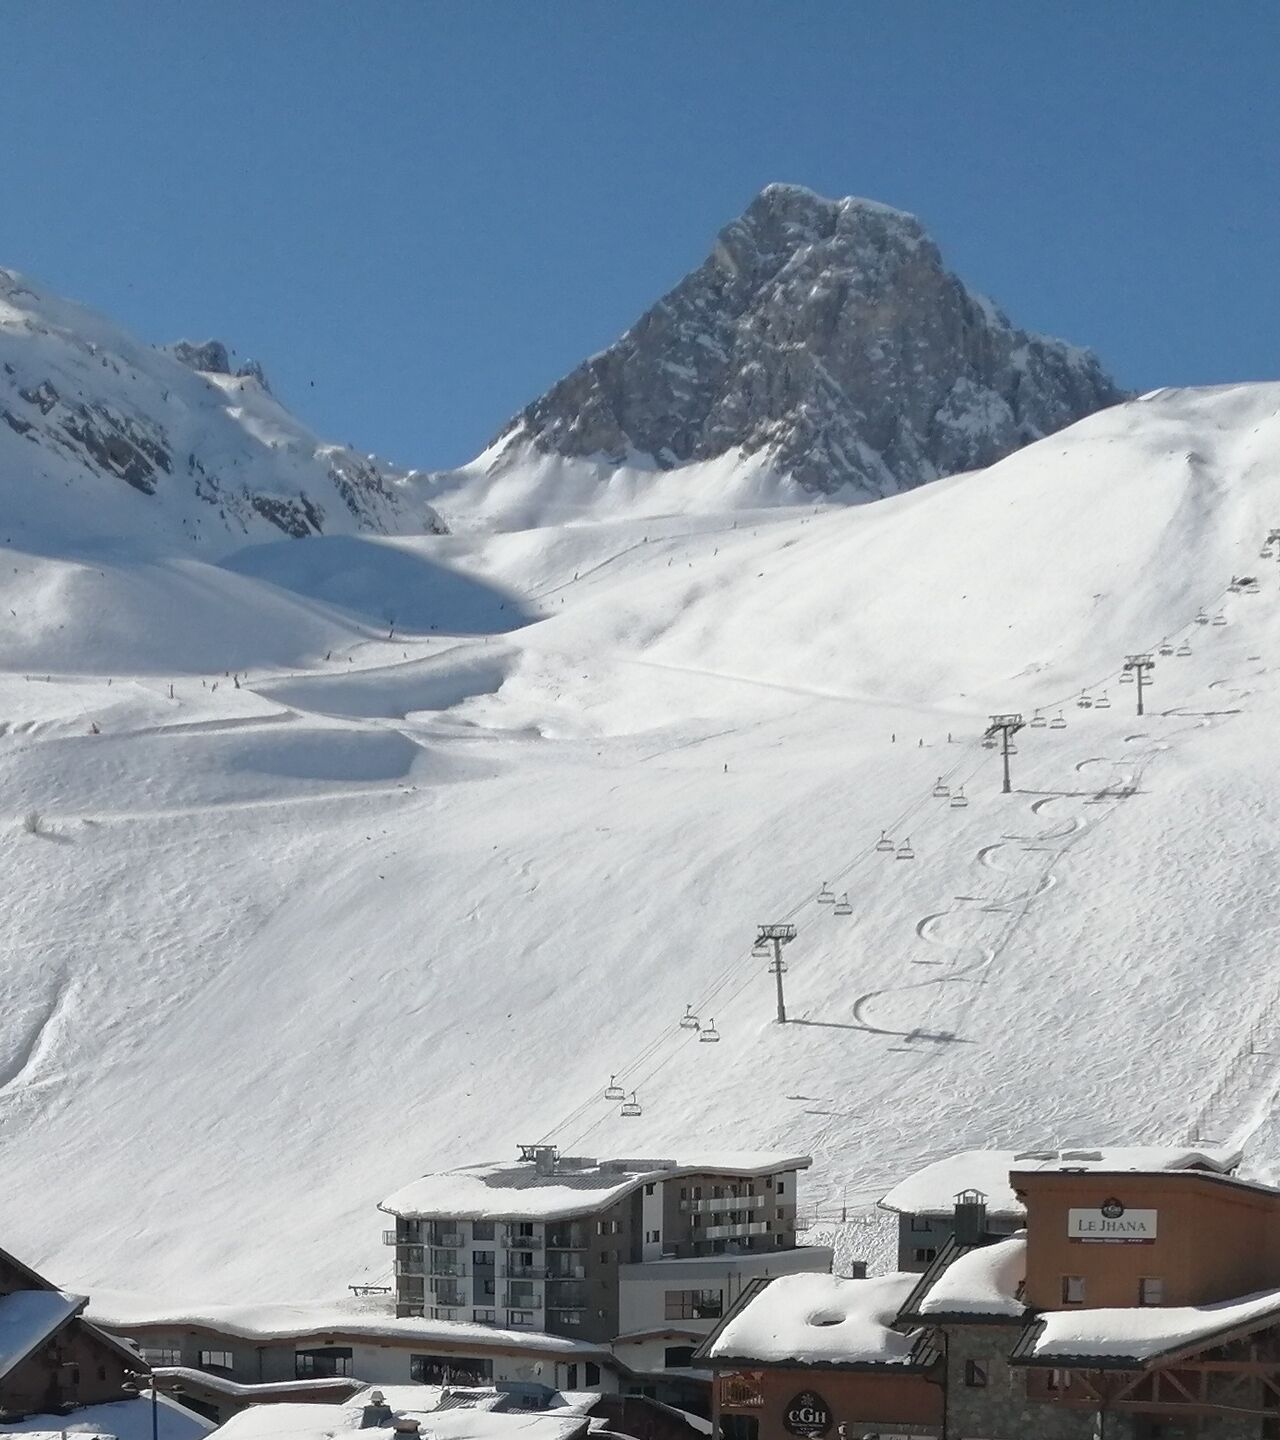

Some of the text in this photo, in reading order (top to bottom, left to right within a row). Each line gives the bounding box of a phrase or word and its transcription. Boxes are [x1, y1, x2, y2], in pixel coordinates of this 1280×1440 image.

[1078, 1219, 1146, 1232] LE JHANA
[788, 1407, 826, 1423] CGH
